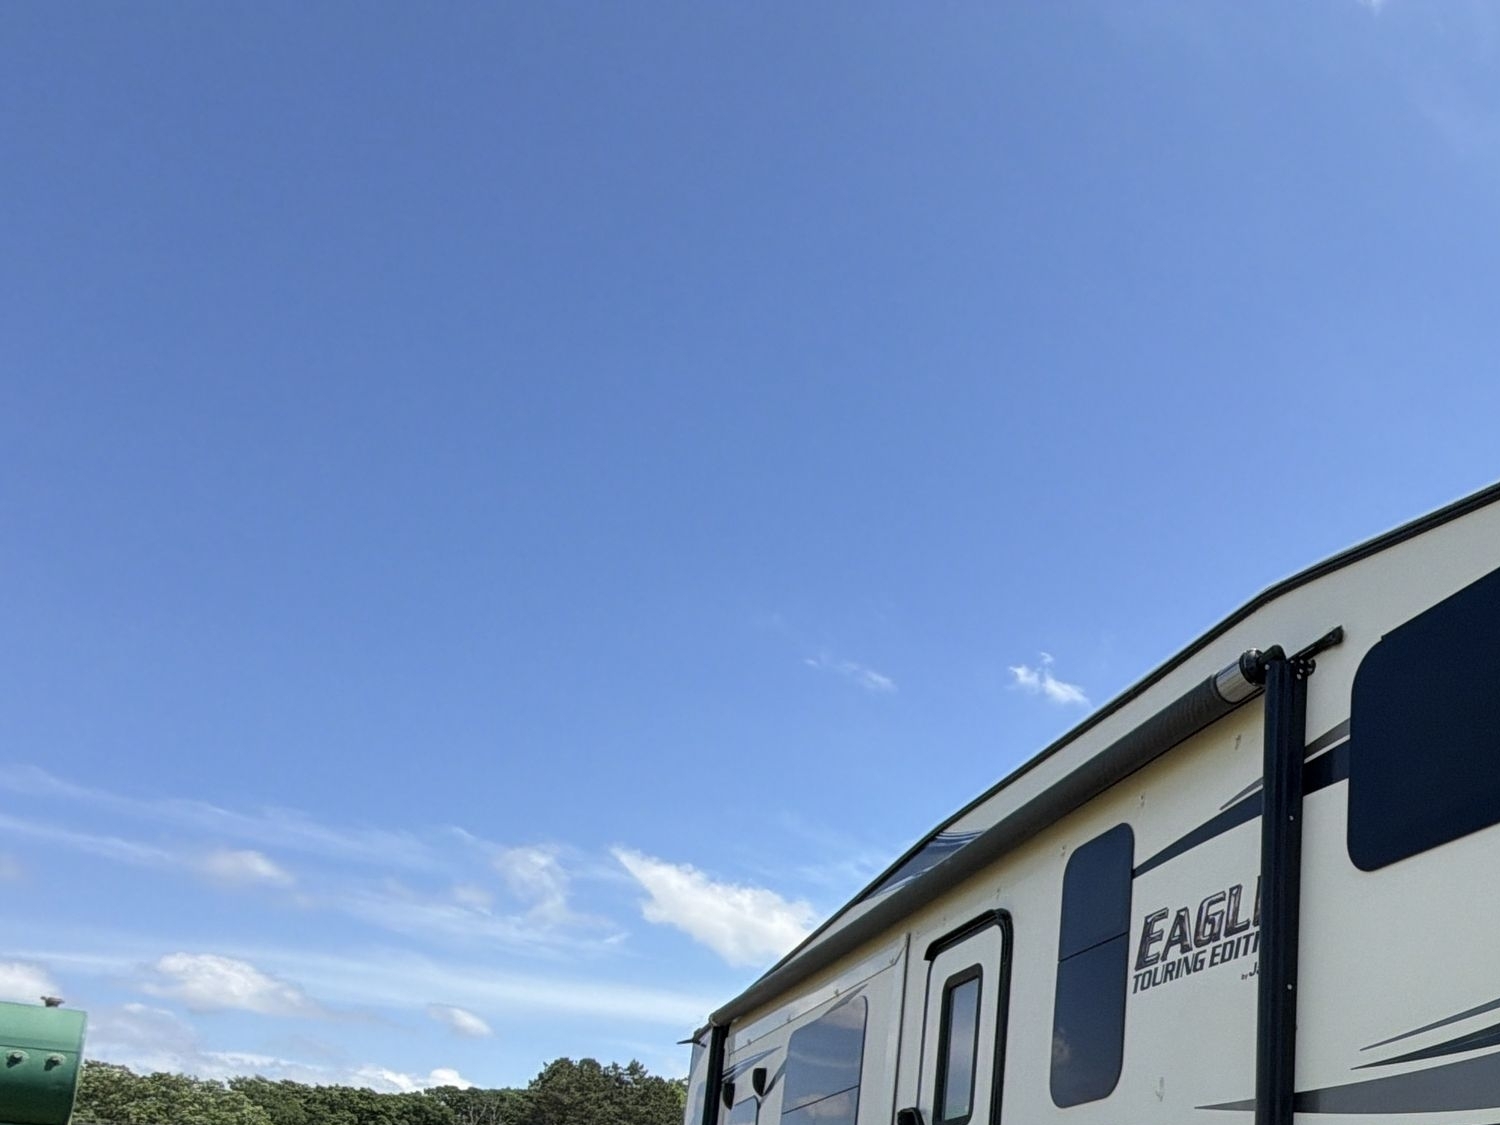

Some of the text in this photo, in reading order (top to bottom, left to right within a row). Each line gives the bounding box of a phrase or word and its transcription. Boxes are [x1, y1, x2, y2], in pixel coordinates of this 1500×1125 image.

[1133, 931, 1260, 994] TOURING EDITI
[1135, 876, 1261, 971] EAGL
